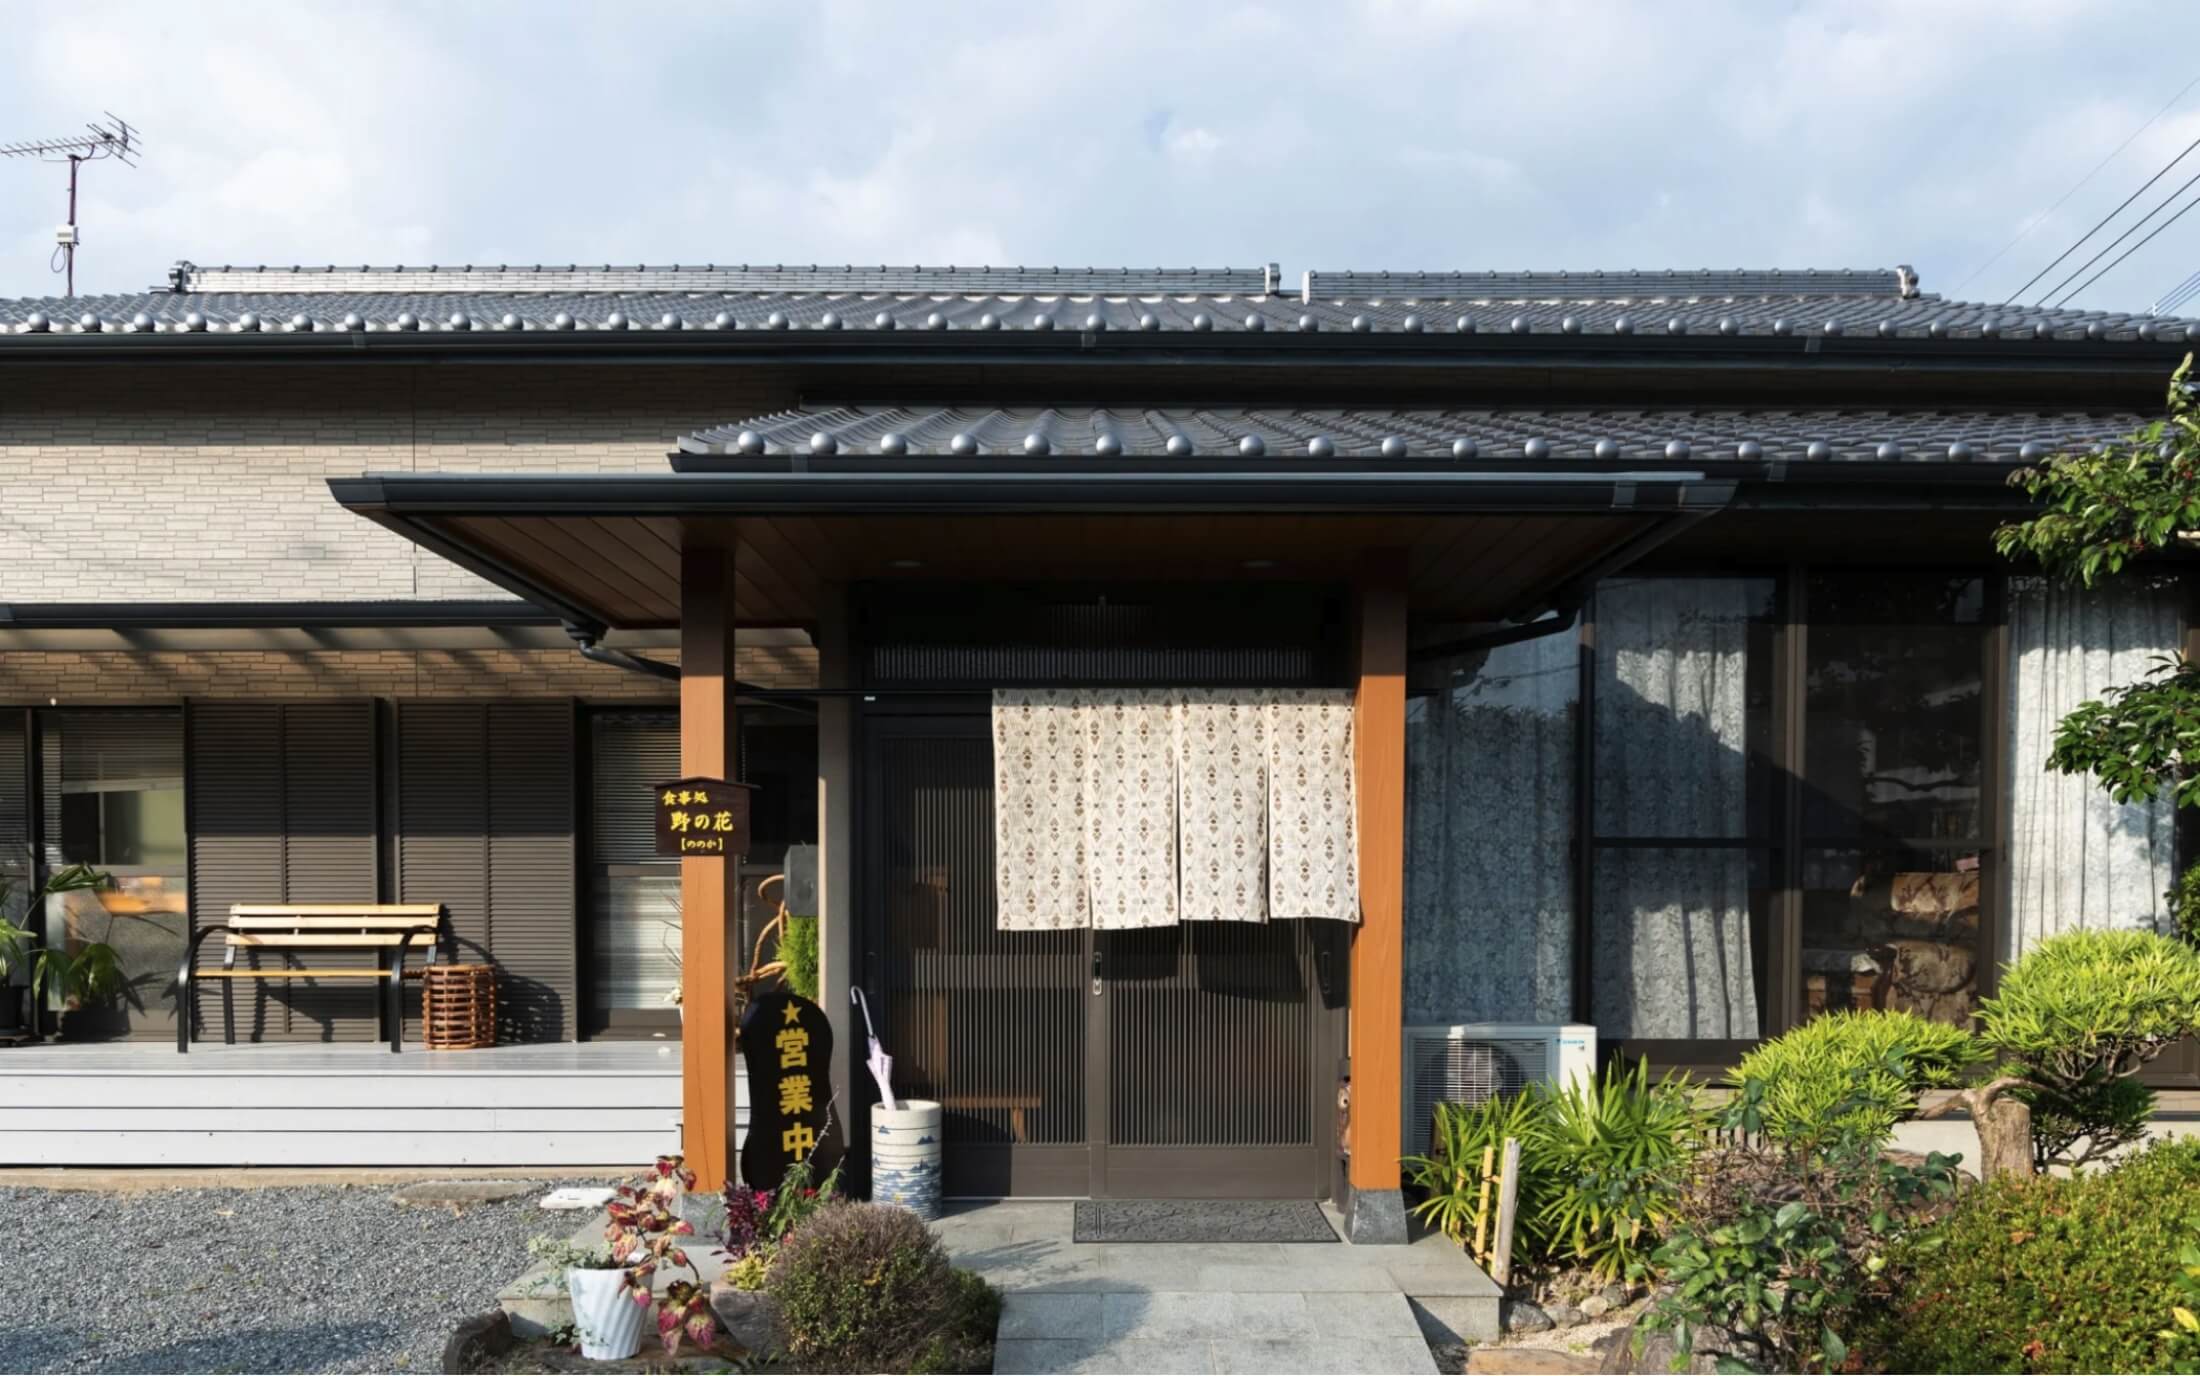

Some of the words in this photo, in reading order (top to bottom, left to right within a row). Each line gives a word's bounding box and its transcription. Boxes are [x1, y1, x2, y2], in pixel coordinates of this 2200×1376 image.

[661, 790, 709, 806] 食事処
[670, 810, 734, 833] 野の花
[776, 1028, 815, 1161] 営業中
